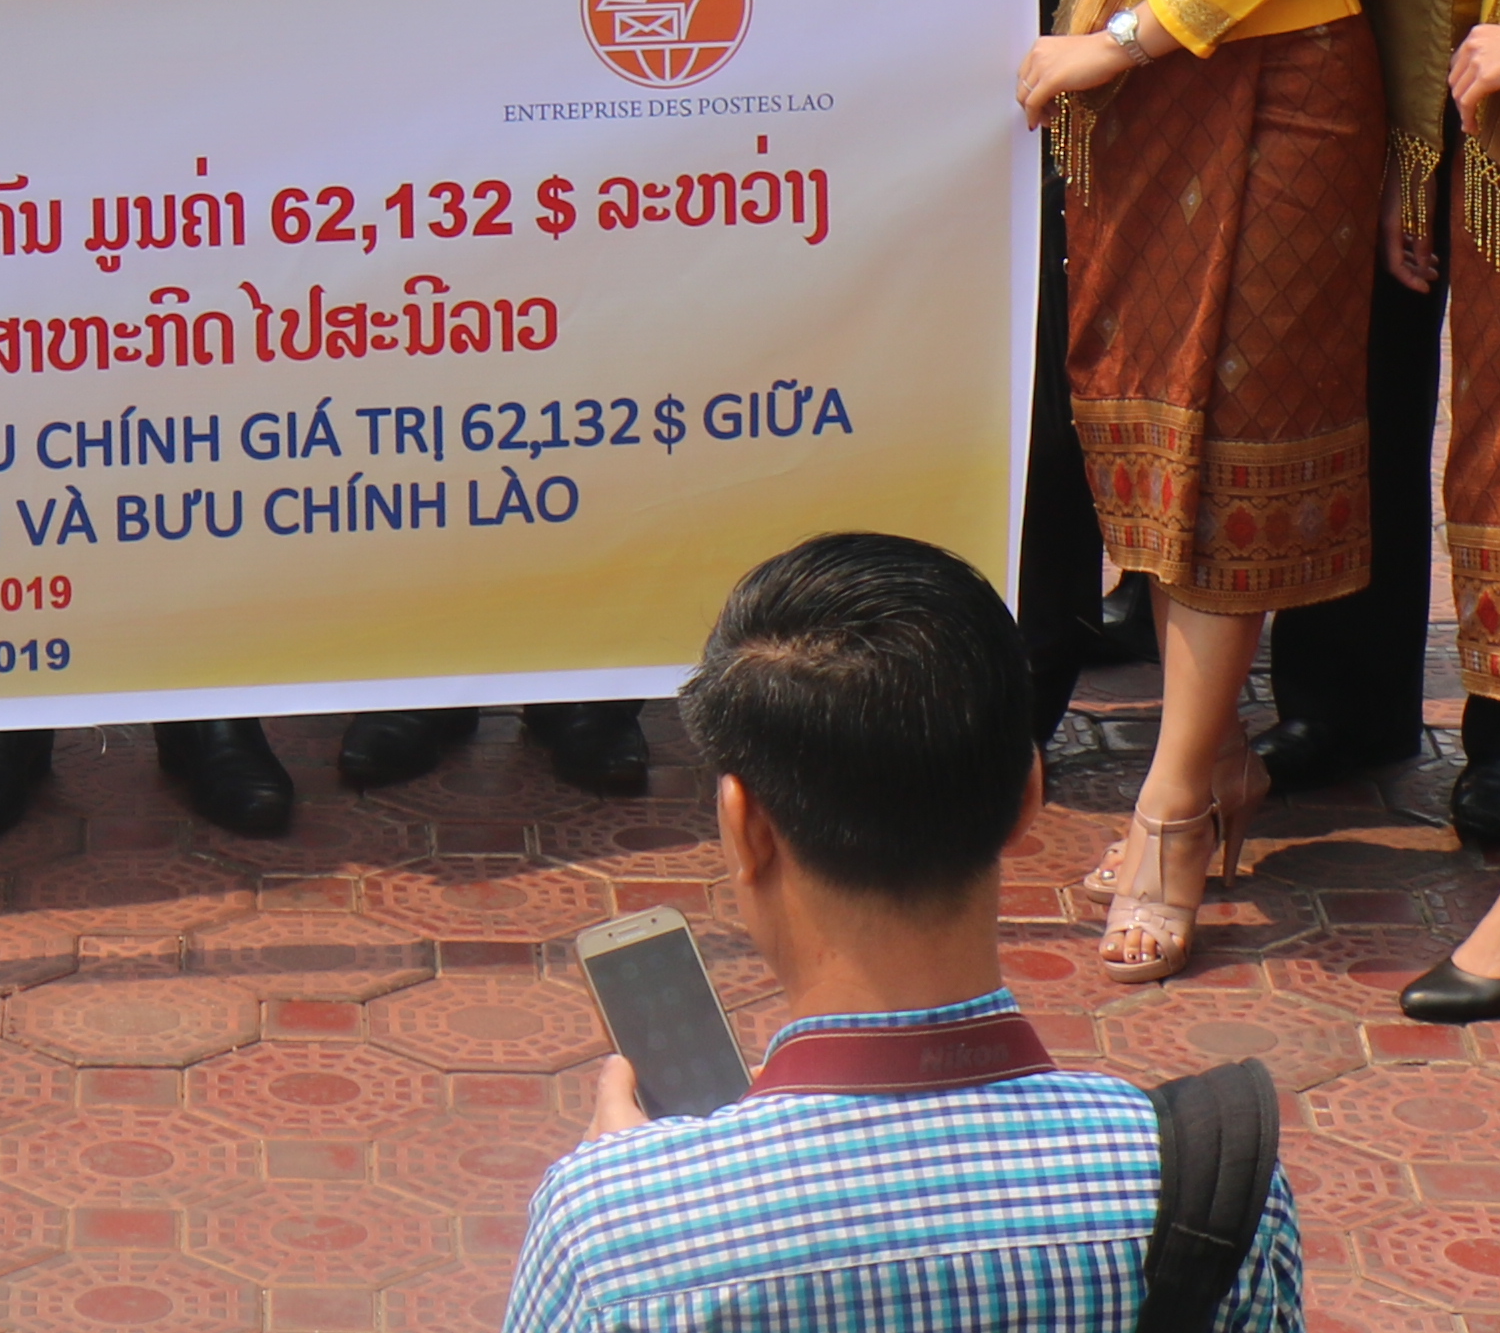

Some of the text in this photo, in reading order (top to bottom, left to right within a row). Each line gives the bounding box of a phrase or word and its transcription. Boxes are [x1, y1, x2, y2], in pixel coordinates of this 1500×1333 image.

[503, 93, 834, 123] ENTREPRISE DES POSTES LAO
[85, 157, 244, 271] ມູນຄ່າ
[272, 180, 511, 252] 62,132
[536, 175, 576, 240] $
[599, 135, 828, 245] ລະຫວ່າງ
[39, 408, 219, 469] CHÍNH
[243, 398, 341, 460] GIÁ
[358, 407, 443, 461] TRỊ
[464, 400, 639, 459] 62,132
[653, 393, 687, 454] $
[706, 382, 852, 439] GIỮA
[19, 487, 97, 546] VÀ
[119, 491, 242, 541] BƯU
[267, 474, 445, 535] CHÍNH
[472, 468, 578, 525] LÀO
[919, 1043, 1009, 1073] Nikon
